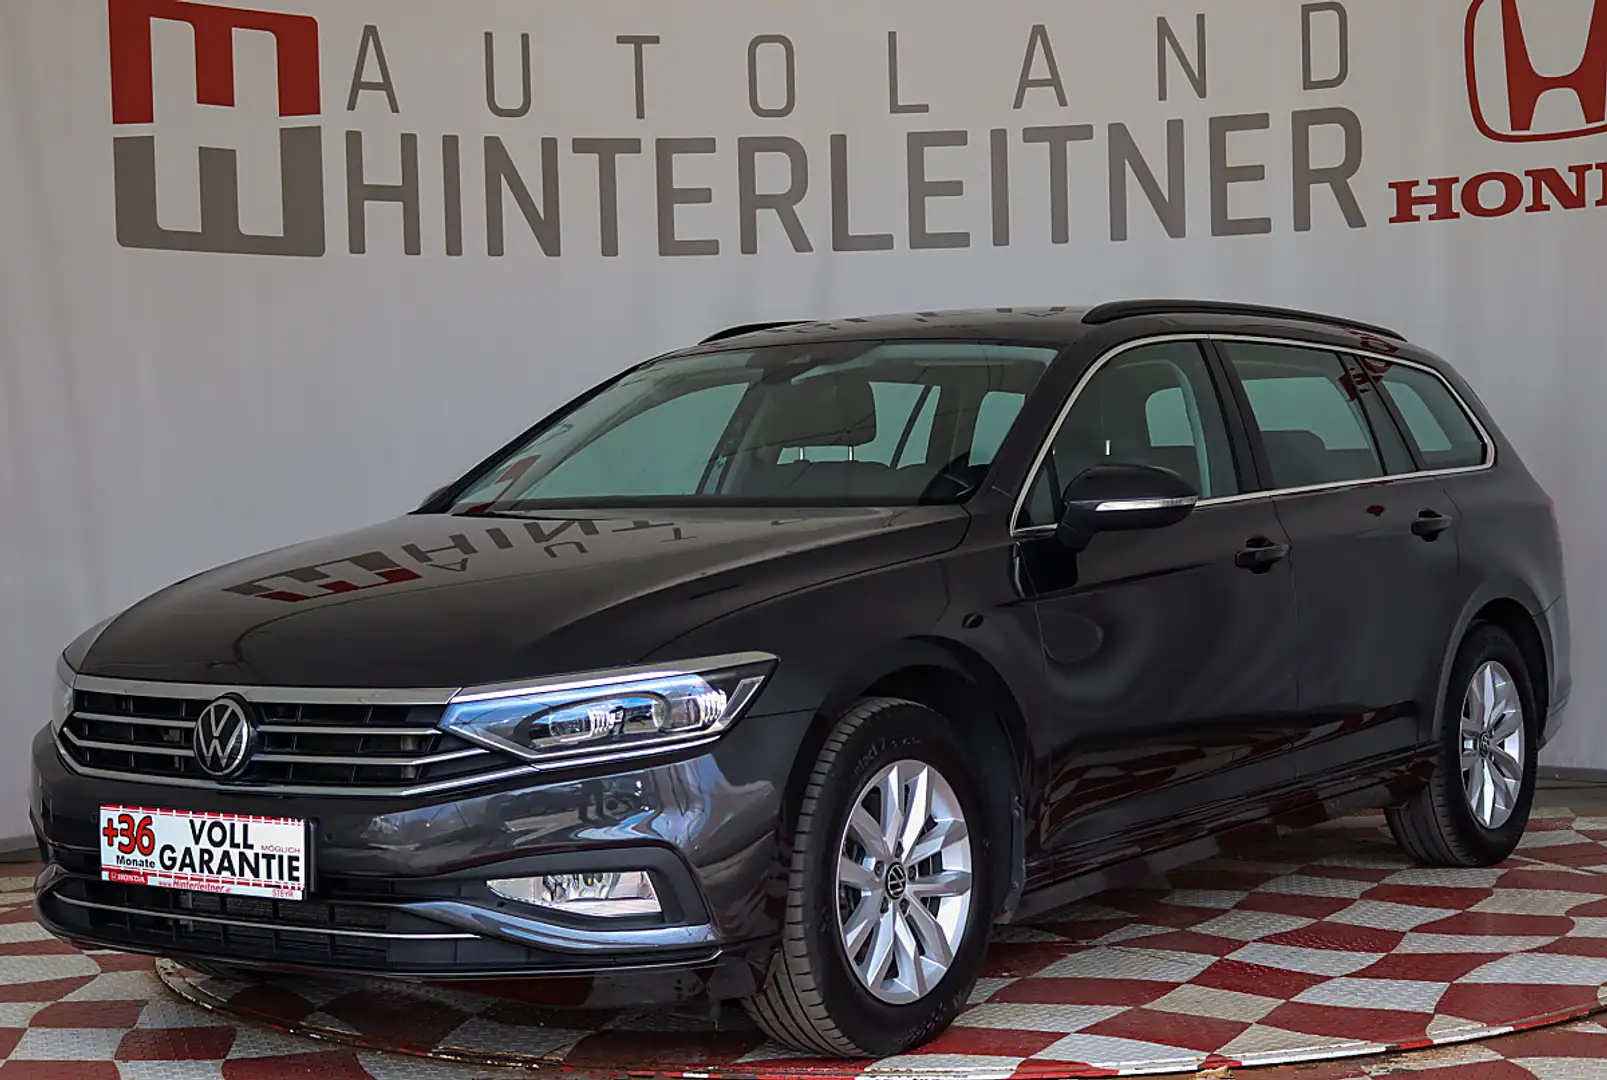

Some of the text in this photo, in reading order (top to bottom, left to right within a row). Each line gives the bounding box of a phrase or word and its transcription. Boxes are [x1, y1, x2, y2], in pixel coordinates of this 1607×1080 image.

[346, 1, 1349, 120] AUTOLAND
[345, 106, 1368, 258] HINTERLEITNER
[1387, 162, 1607, 224] HON
[102, 813, 156, 857] +36
[189, 818, 255, 850] VOLL
[116, 854, 156, 870] Monate
[117, 874, 146, 884] HONDA
[159, 844, 301, 882] GARANTIE
